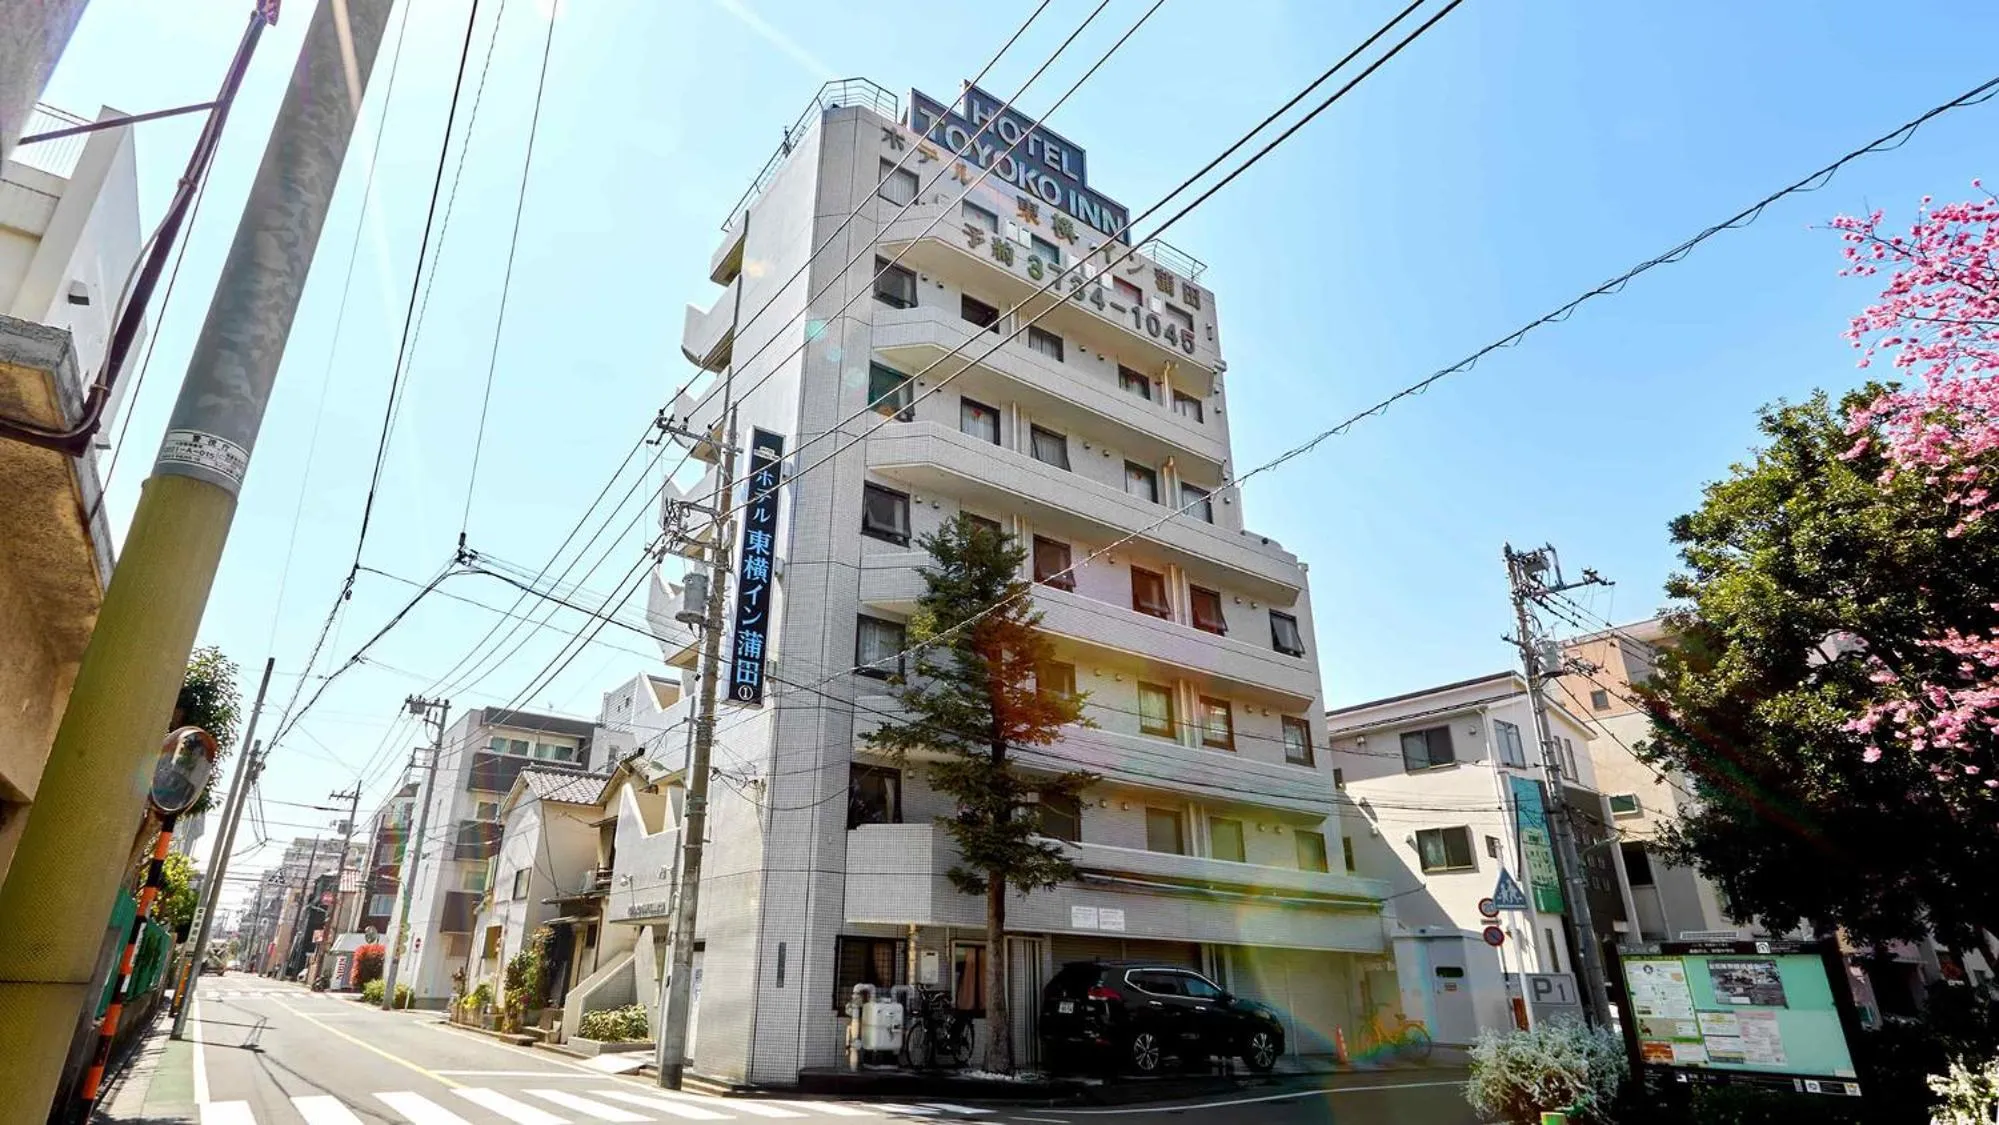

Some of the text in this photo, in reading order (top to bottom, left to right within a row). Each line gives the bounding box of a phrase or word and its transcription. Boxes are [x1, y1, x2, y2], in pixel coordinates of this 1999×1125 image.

[919, 107, 1126, 238] TOYOKO INN
[972, 100, 1079, 182] HOTEL
